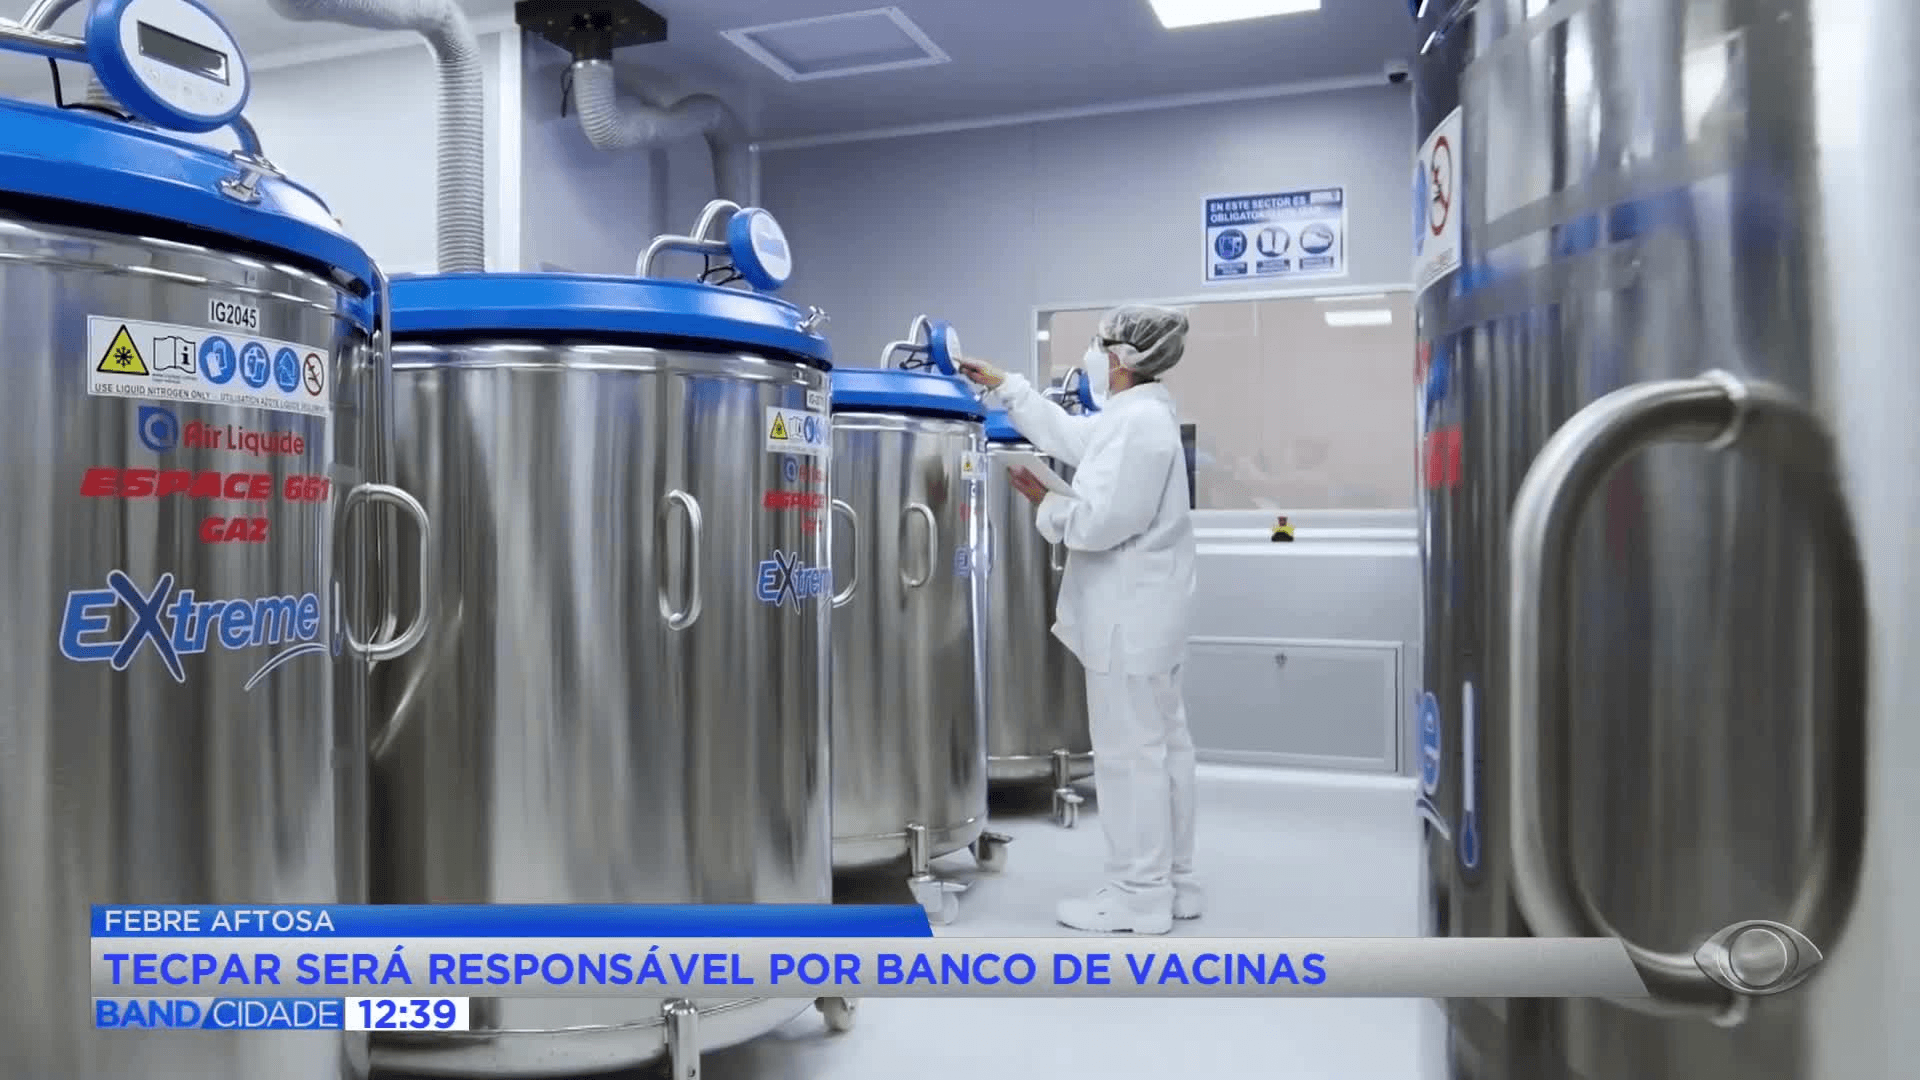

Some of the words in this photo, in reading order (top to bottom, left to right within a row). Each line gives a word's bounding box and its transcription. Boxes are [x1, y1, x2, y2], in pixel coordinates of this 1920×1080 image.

[1210, 202, 1224, 212] EN
[1225, 200, 1249, 211] ESTE
[1251, 197, 1291, 210] SECTOR
[210, 301, 257, 329] IG2045
[95, 383, 113, 393] USE
[116, 384, 146, 395] LIQUID
[147, 387, 189, 398] NITROGEN
[191, 389, 211, 400] ONLY
[183, 420, 222, 449] Air
[226, 424, 305, 456] Liquide
[80, 468, 273, 500] ESPACE
[283, 475, 330, 503] 661
[200, 514, 270, 544] GAZ
